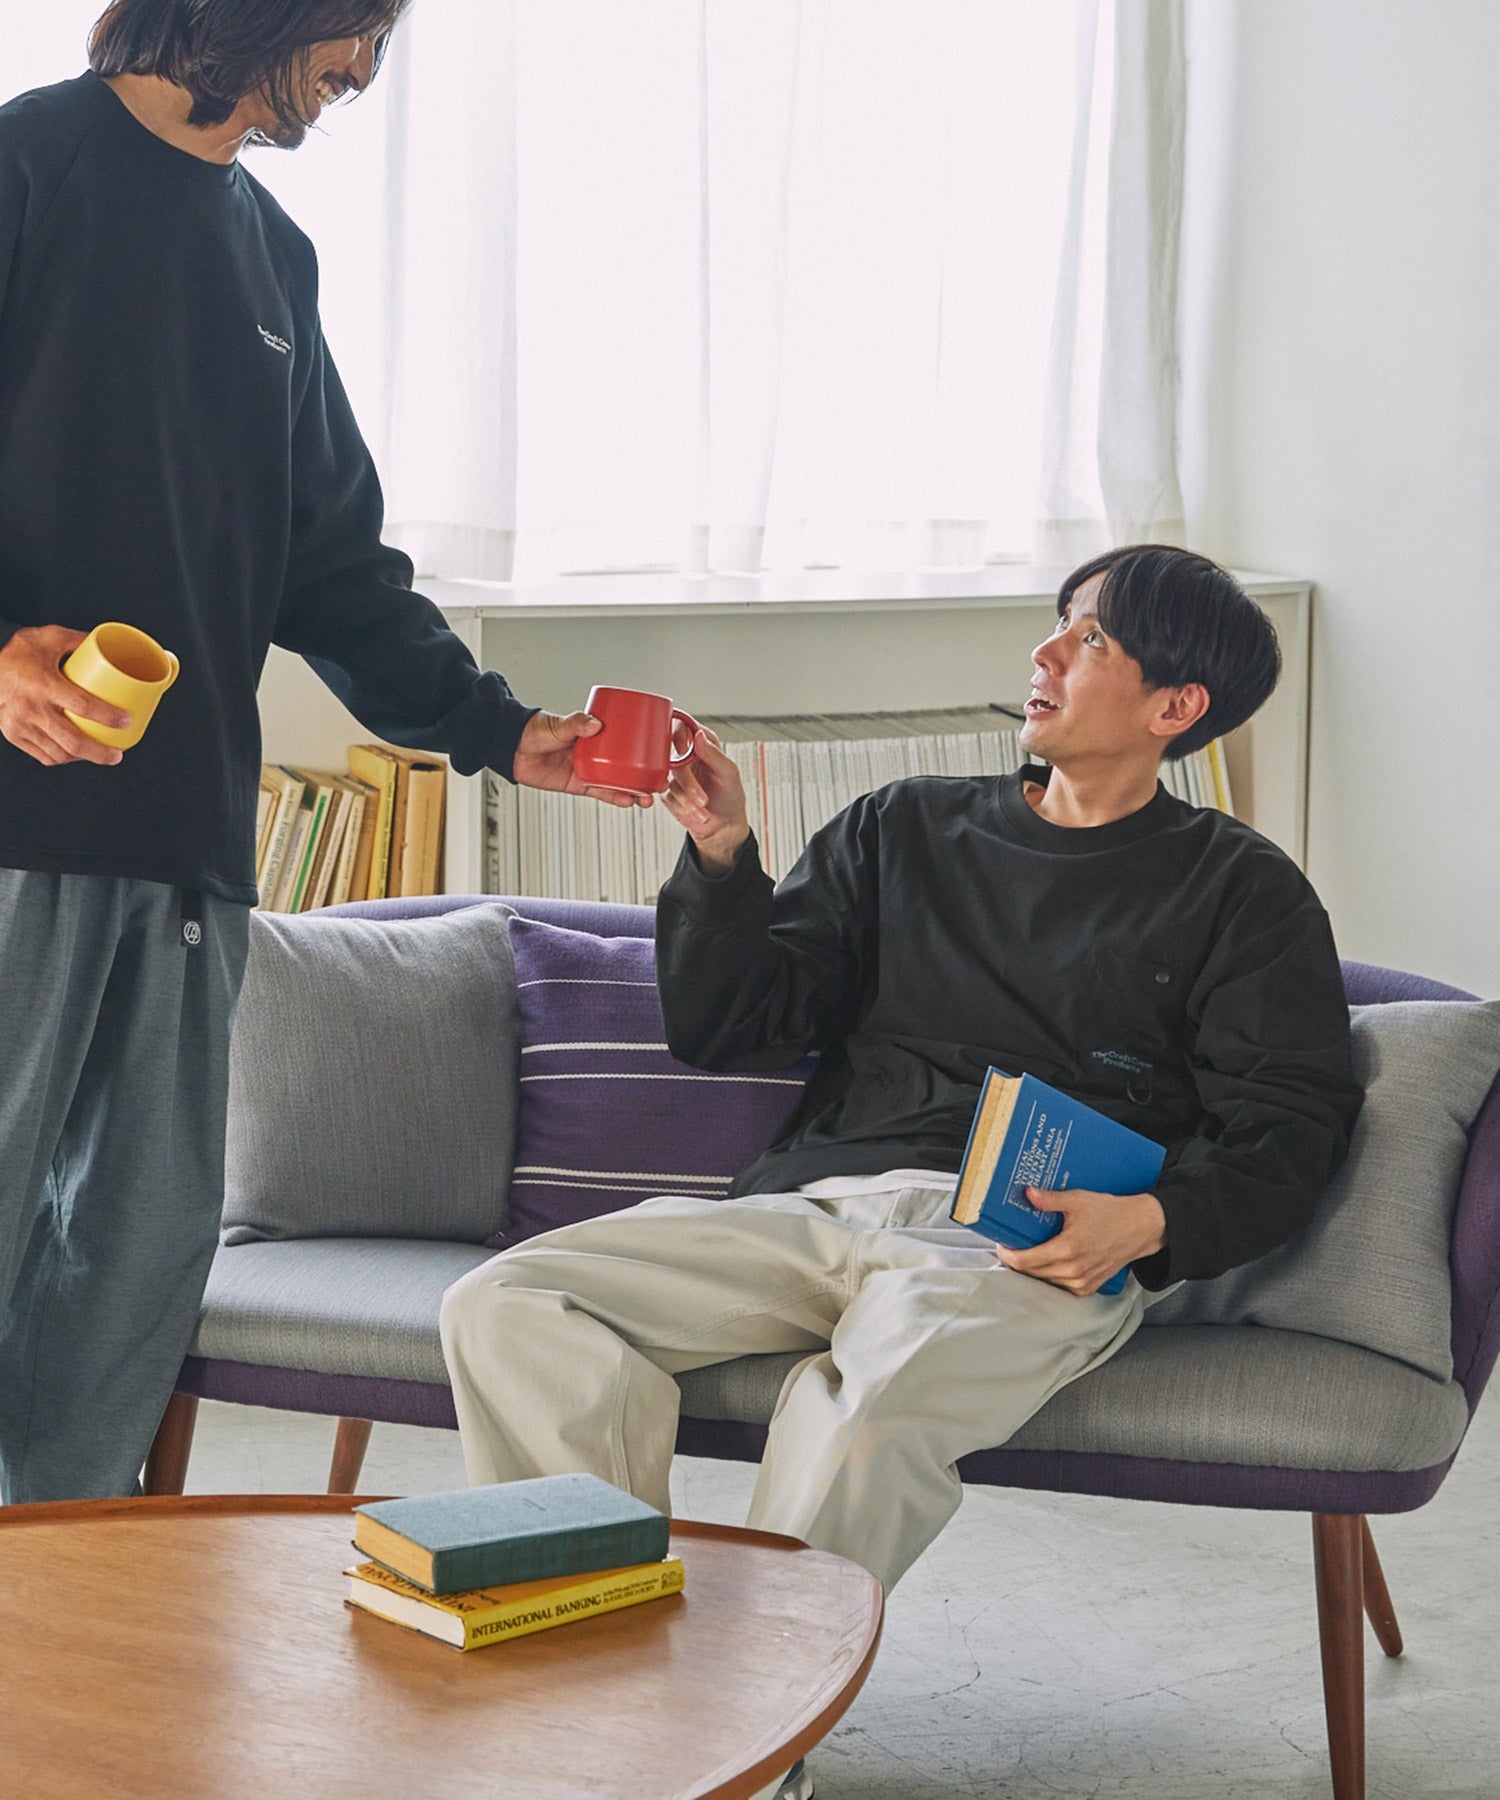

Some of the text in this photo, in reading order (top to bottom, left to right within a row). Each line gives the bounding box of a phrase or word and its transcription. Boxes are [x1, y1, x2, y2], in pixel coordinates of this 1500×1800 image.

[1036, 1113, 1047, 1137] AND
[1045, 1127, 1056, 1152] ASIA
[472, 1607, 553, 1639] INTERNATIONAL
[555, 1594, 601, 1617] BANKING
